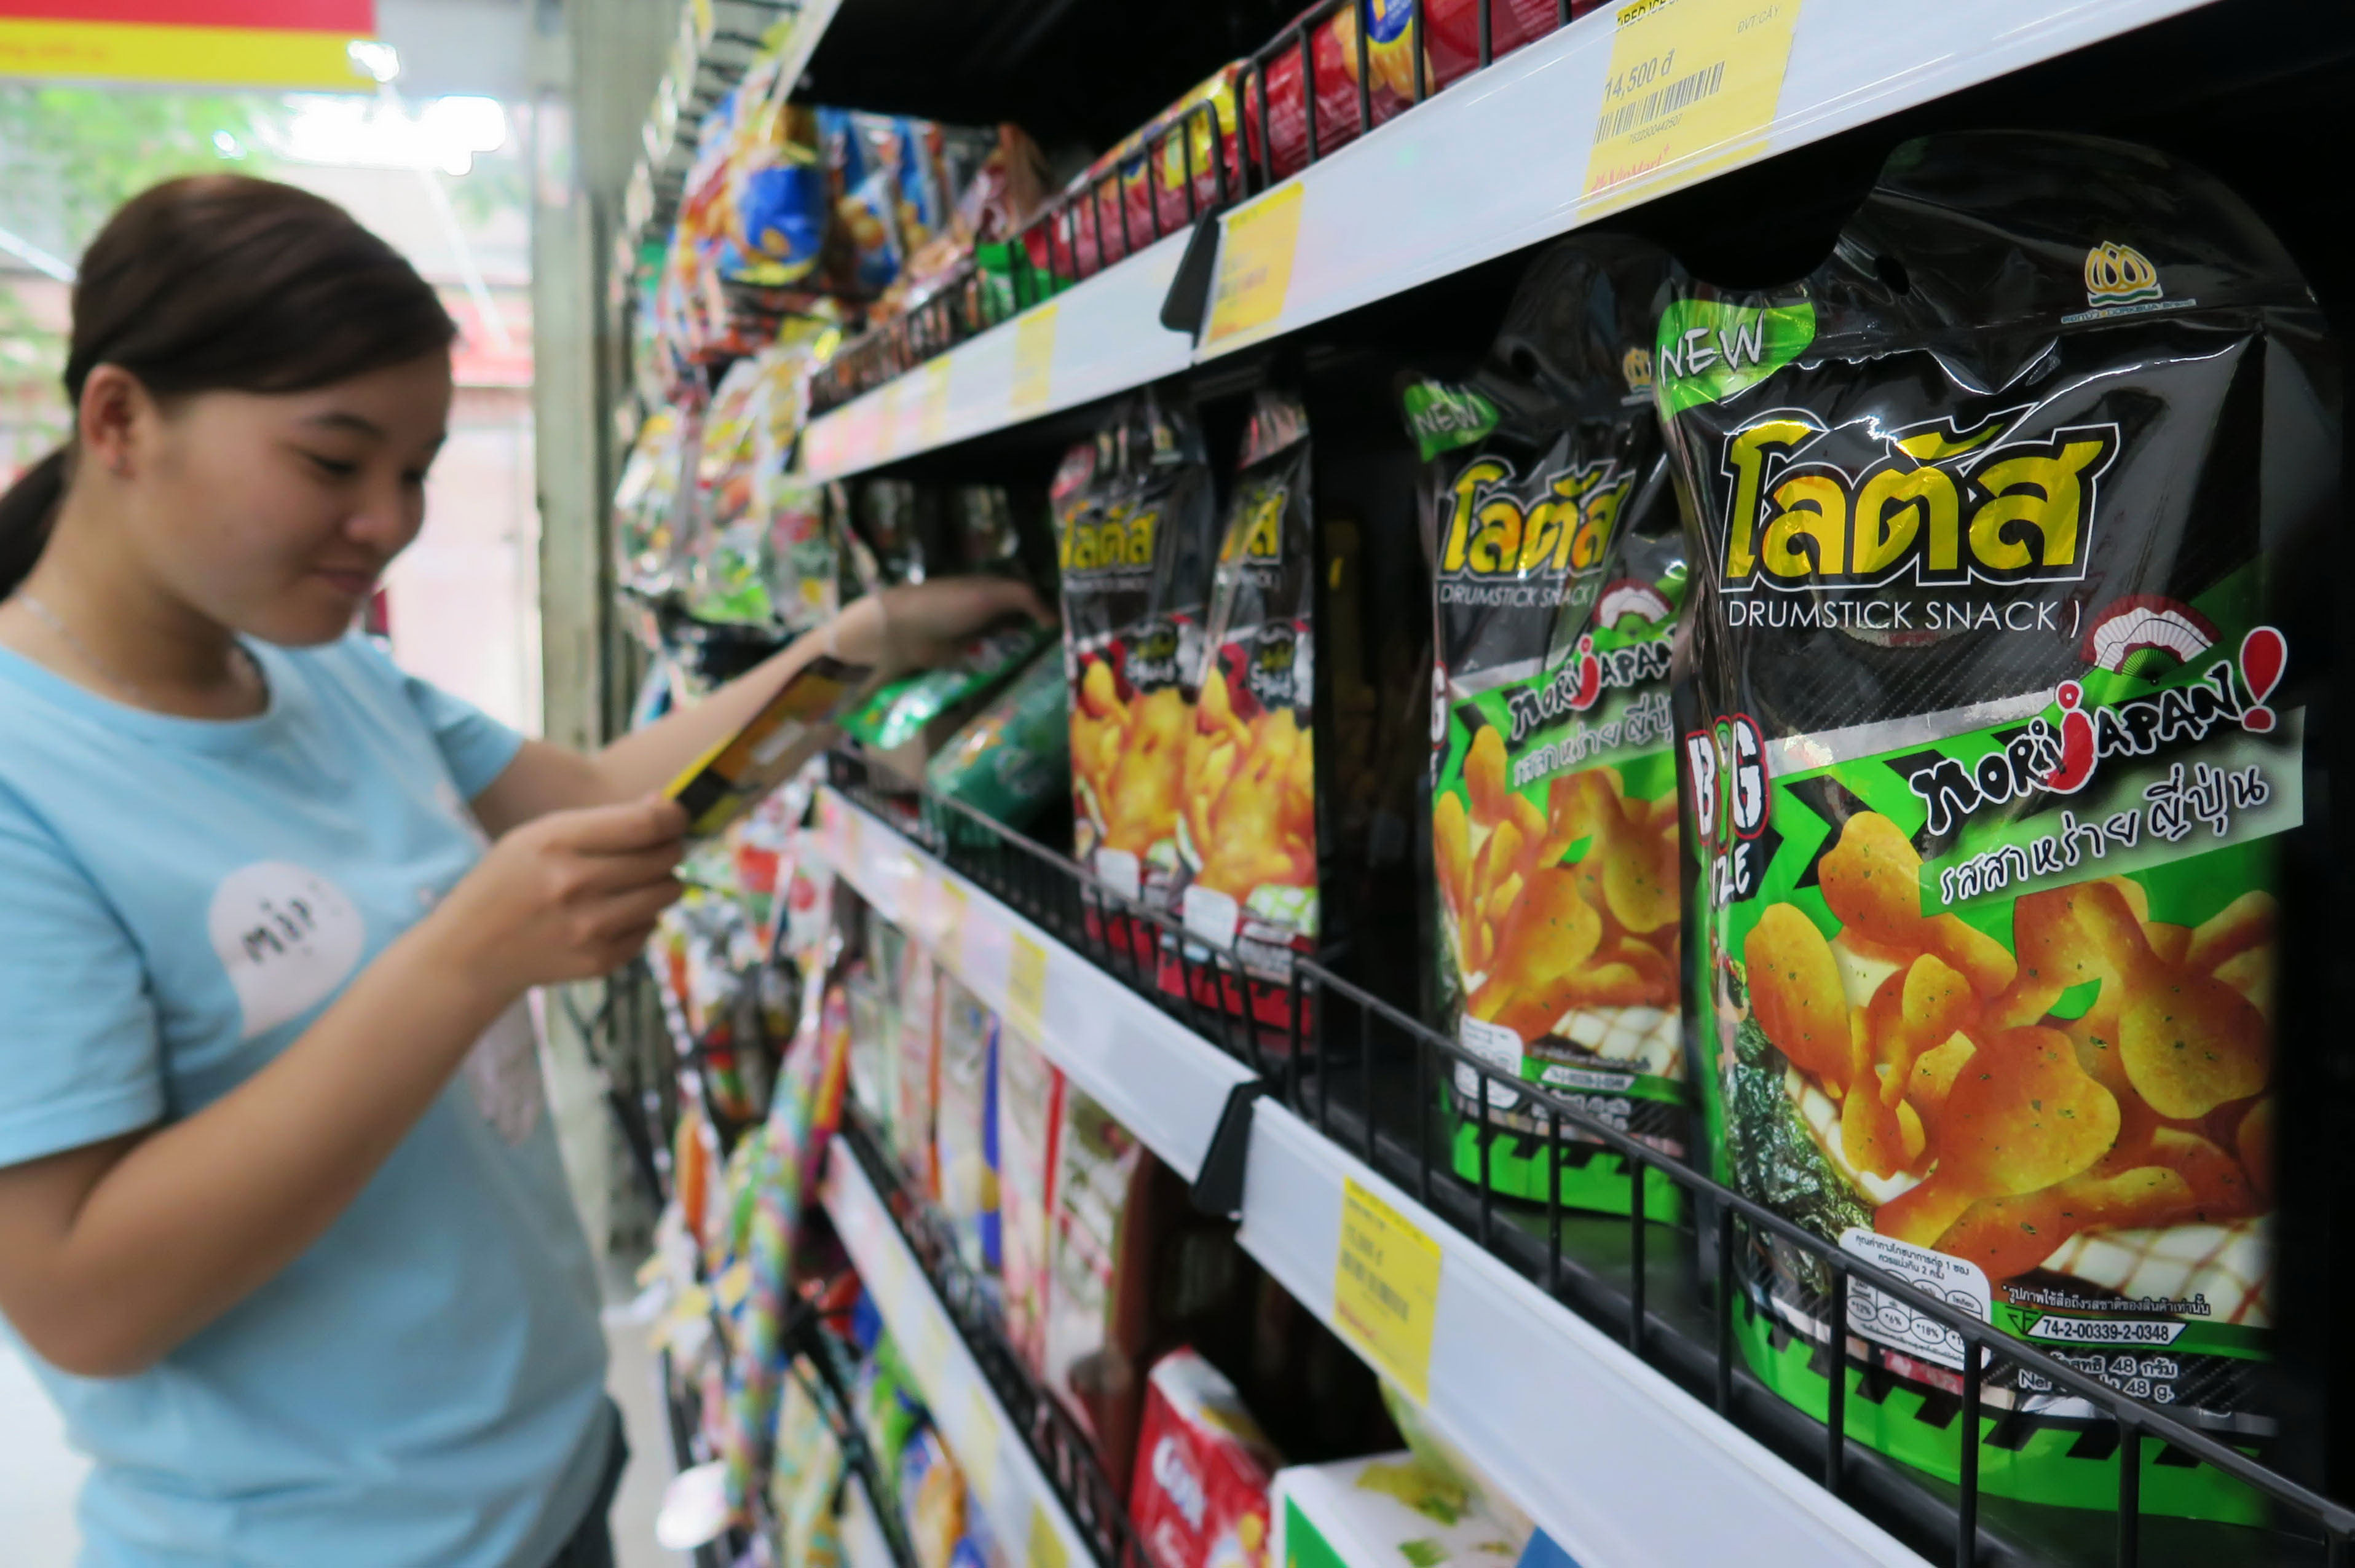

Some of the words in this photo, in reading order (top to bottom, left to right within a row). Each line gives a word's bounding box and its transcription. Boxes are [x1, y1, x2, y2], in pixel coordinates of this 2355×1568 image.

[1604, 57, 1658, 103] 14,500
[1660, 309, 1765, 389] NEW
[1414, 396, 1480, 438] NEW
[1442, 459, 1634, 573] โลตัส
[1723, 416, 2108, 581] โลตัส
[1729, 601, 1912, 629] DRUMSTICK
[1925, 601, 2057, 631] SNACK
[1711, 842, 1752, 909] IZE
[1922, 1265, 1928, 1275] 2
[2043, 1319, 2169, 1341] 74-2-00339-2-0348
[2111, 1357, 2136, 1374] 48
[2124, 1379, 2149, 1397] 48
